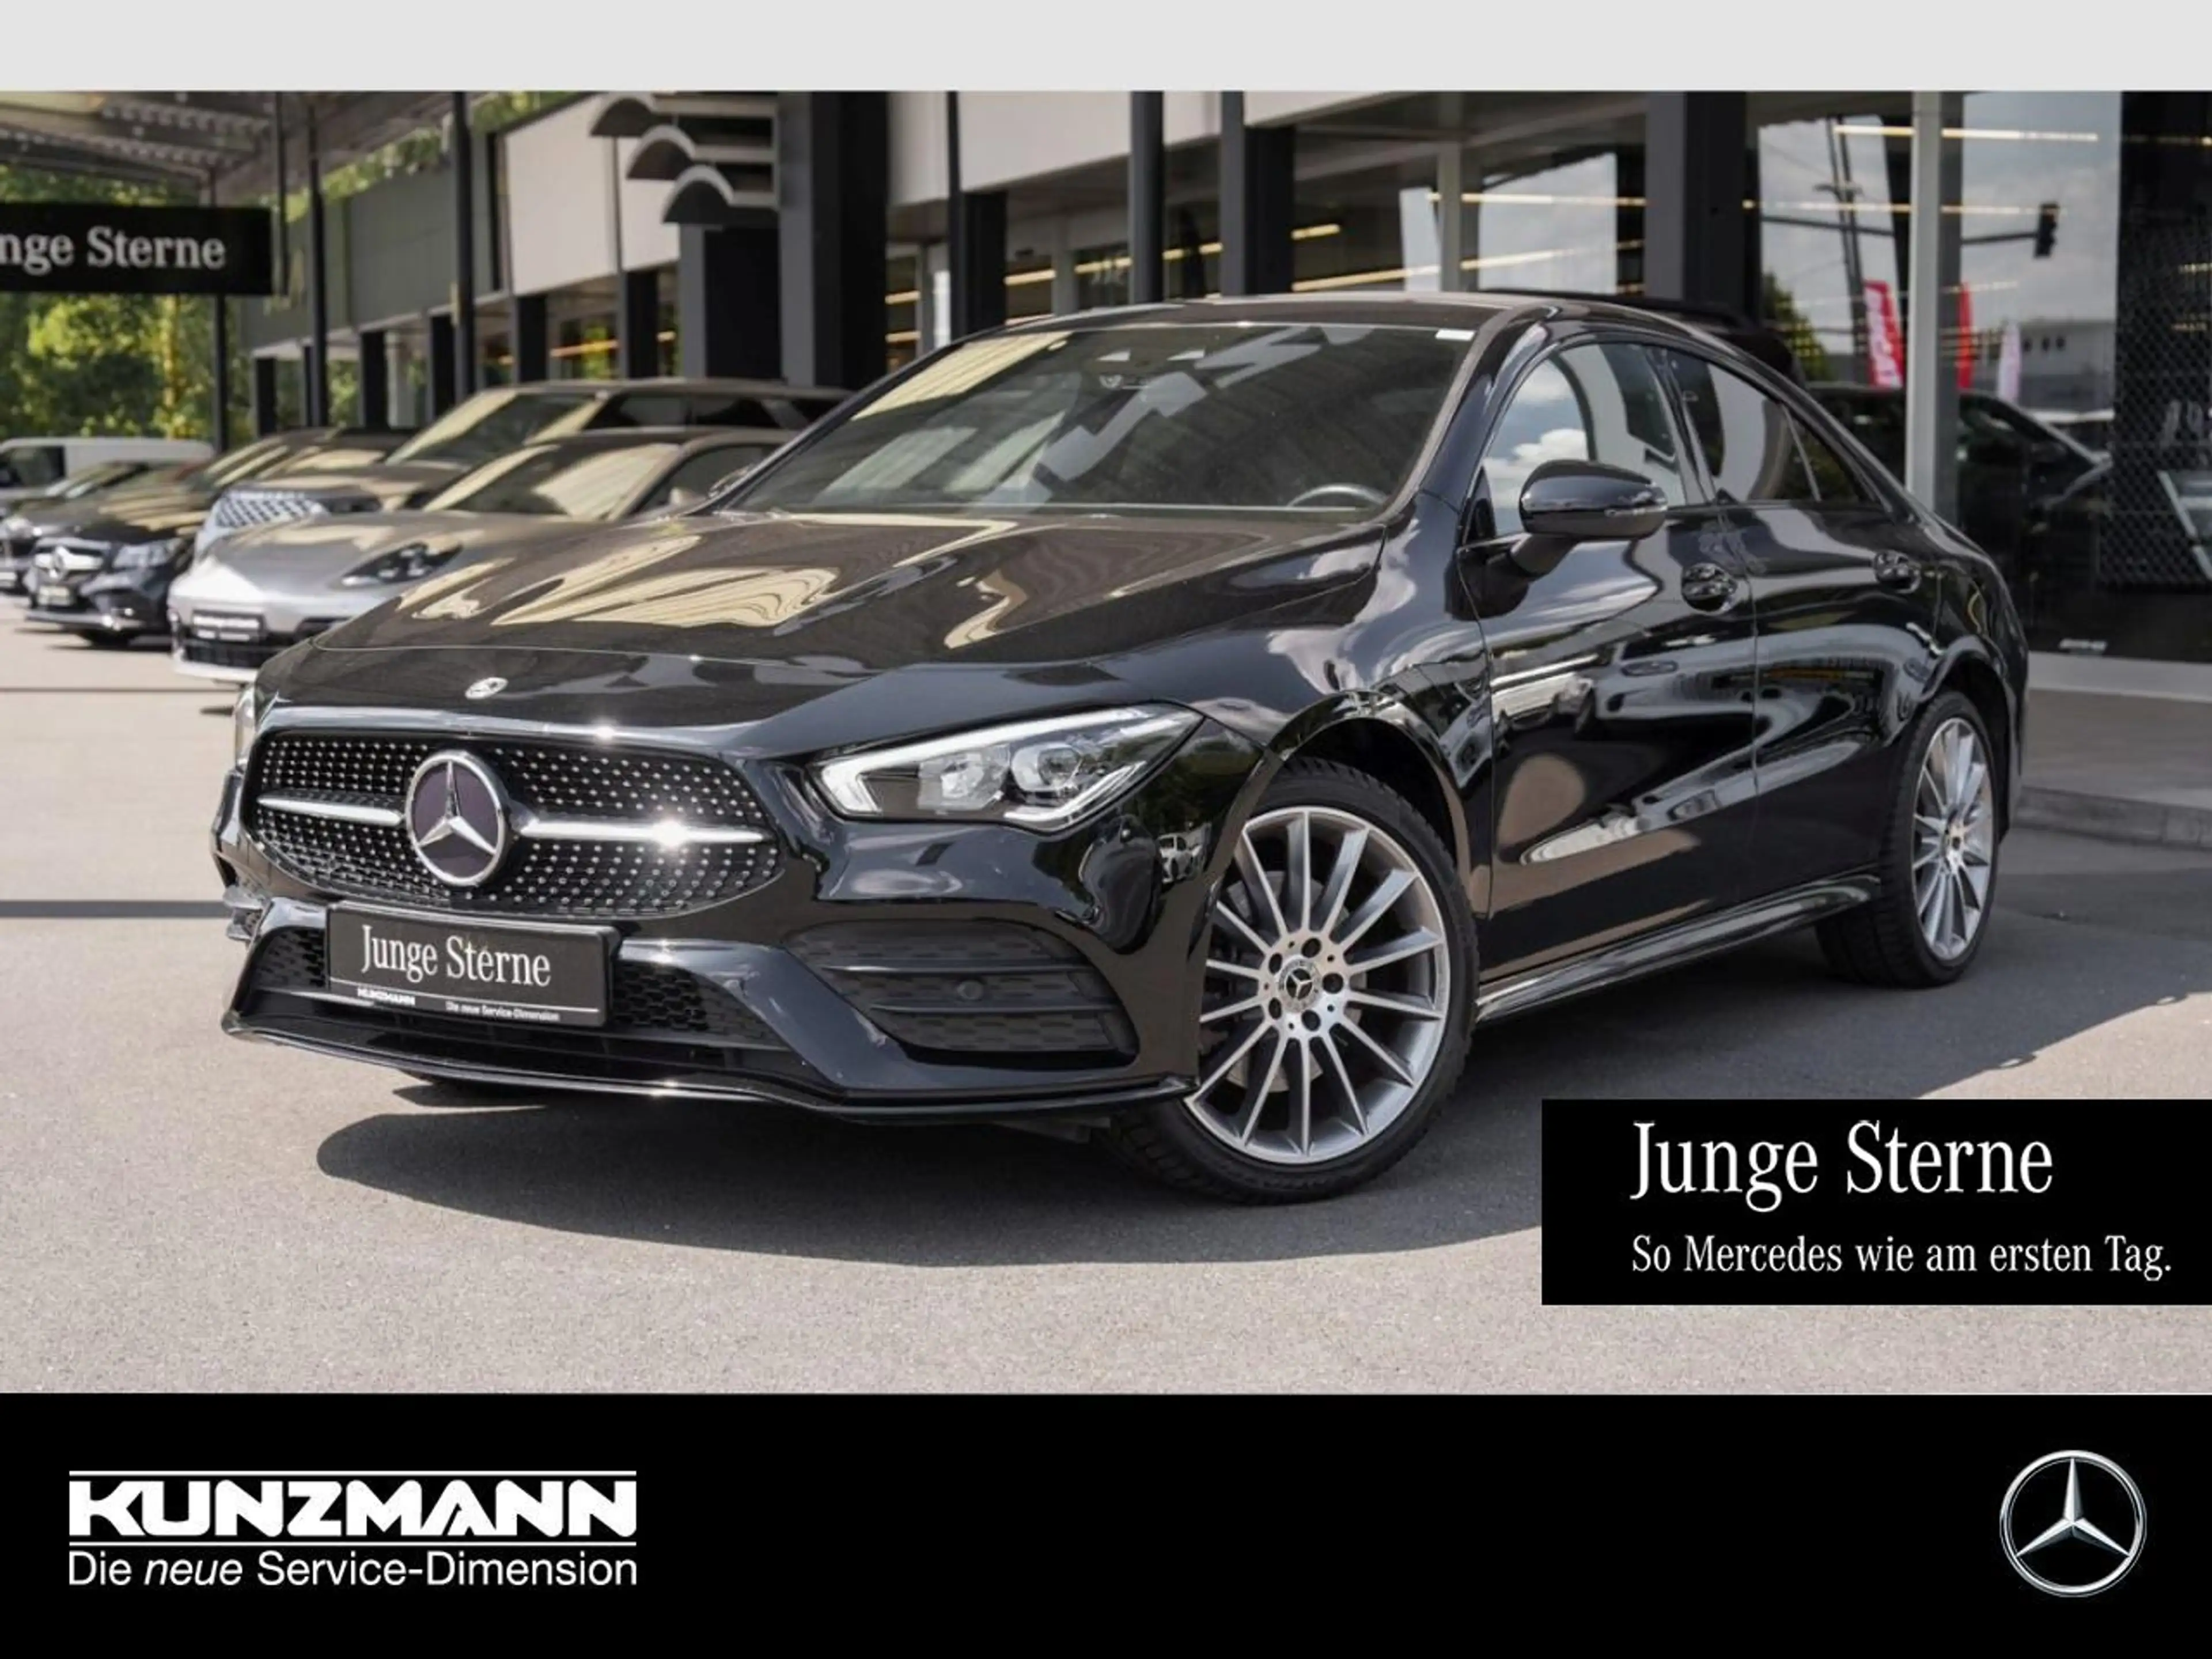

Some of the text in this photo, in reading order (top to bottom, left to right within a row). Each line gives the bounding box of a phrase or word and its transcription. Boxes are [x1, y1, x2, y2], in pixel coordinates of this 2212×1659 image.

[86, 226, 226, 269] Sterne
[361, 924, 551, 987] Junge Sterne
